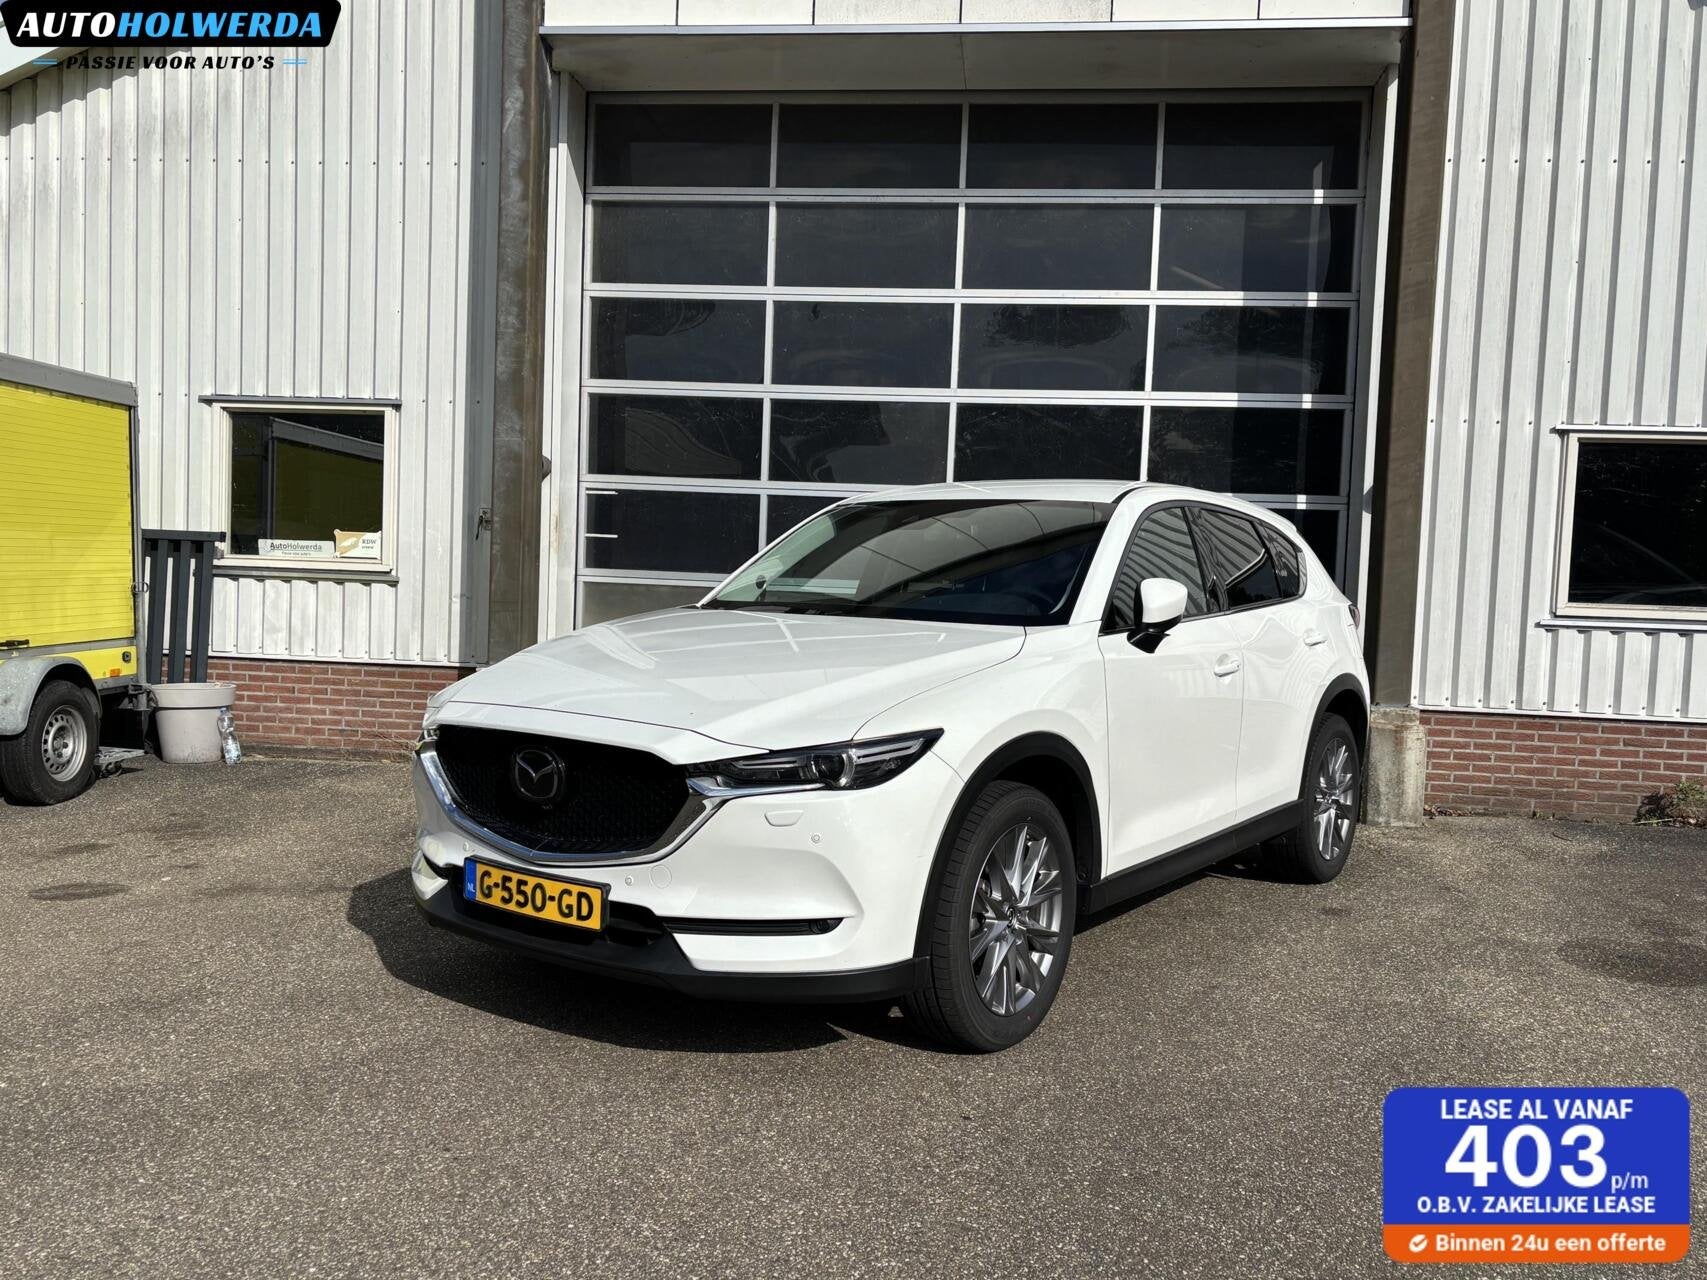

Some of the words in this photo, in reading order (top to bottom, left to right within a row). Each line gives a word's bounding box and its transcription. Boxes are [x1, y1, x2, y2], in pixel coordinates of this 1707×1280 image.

[270, 541, 322, 551] AutoHolwerda
[467, 883, 476, 893] NL
[480, 870, 594, 921] G-550-GD
